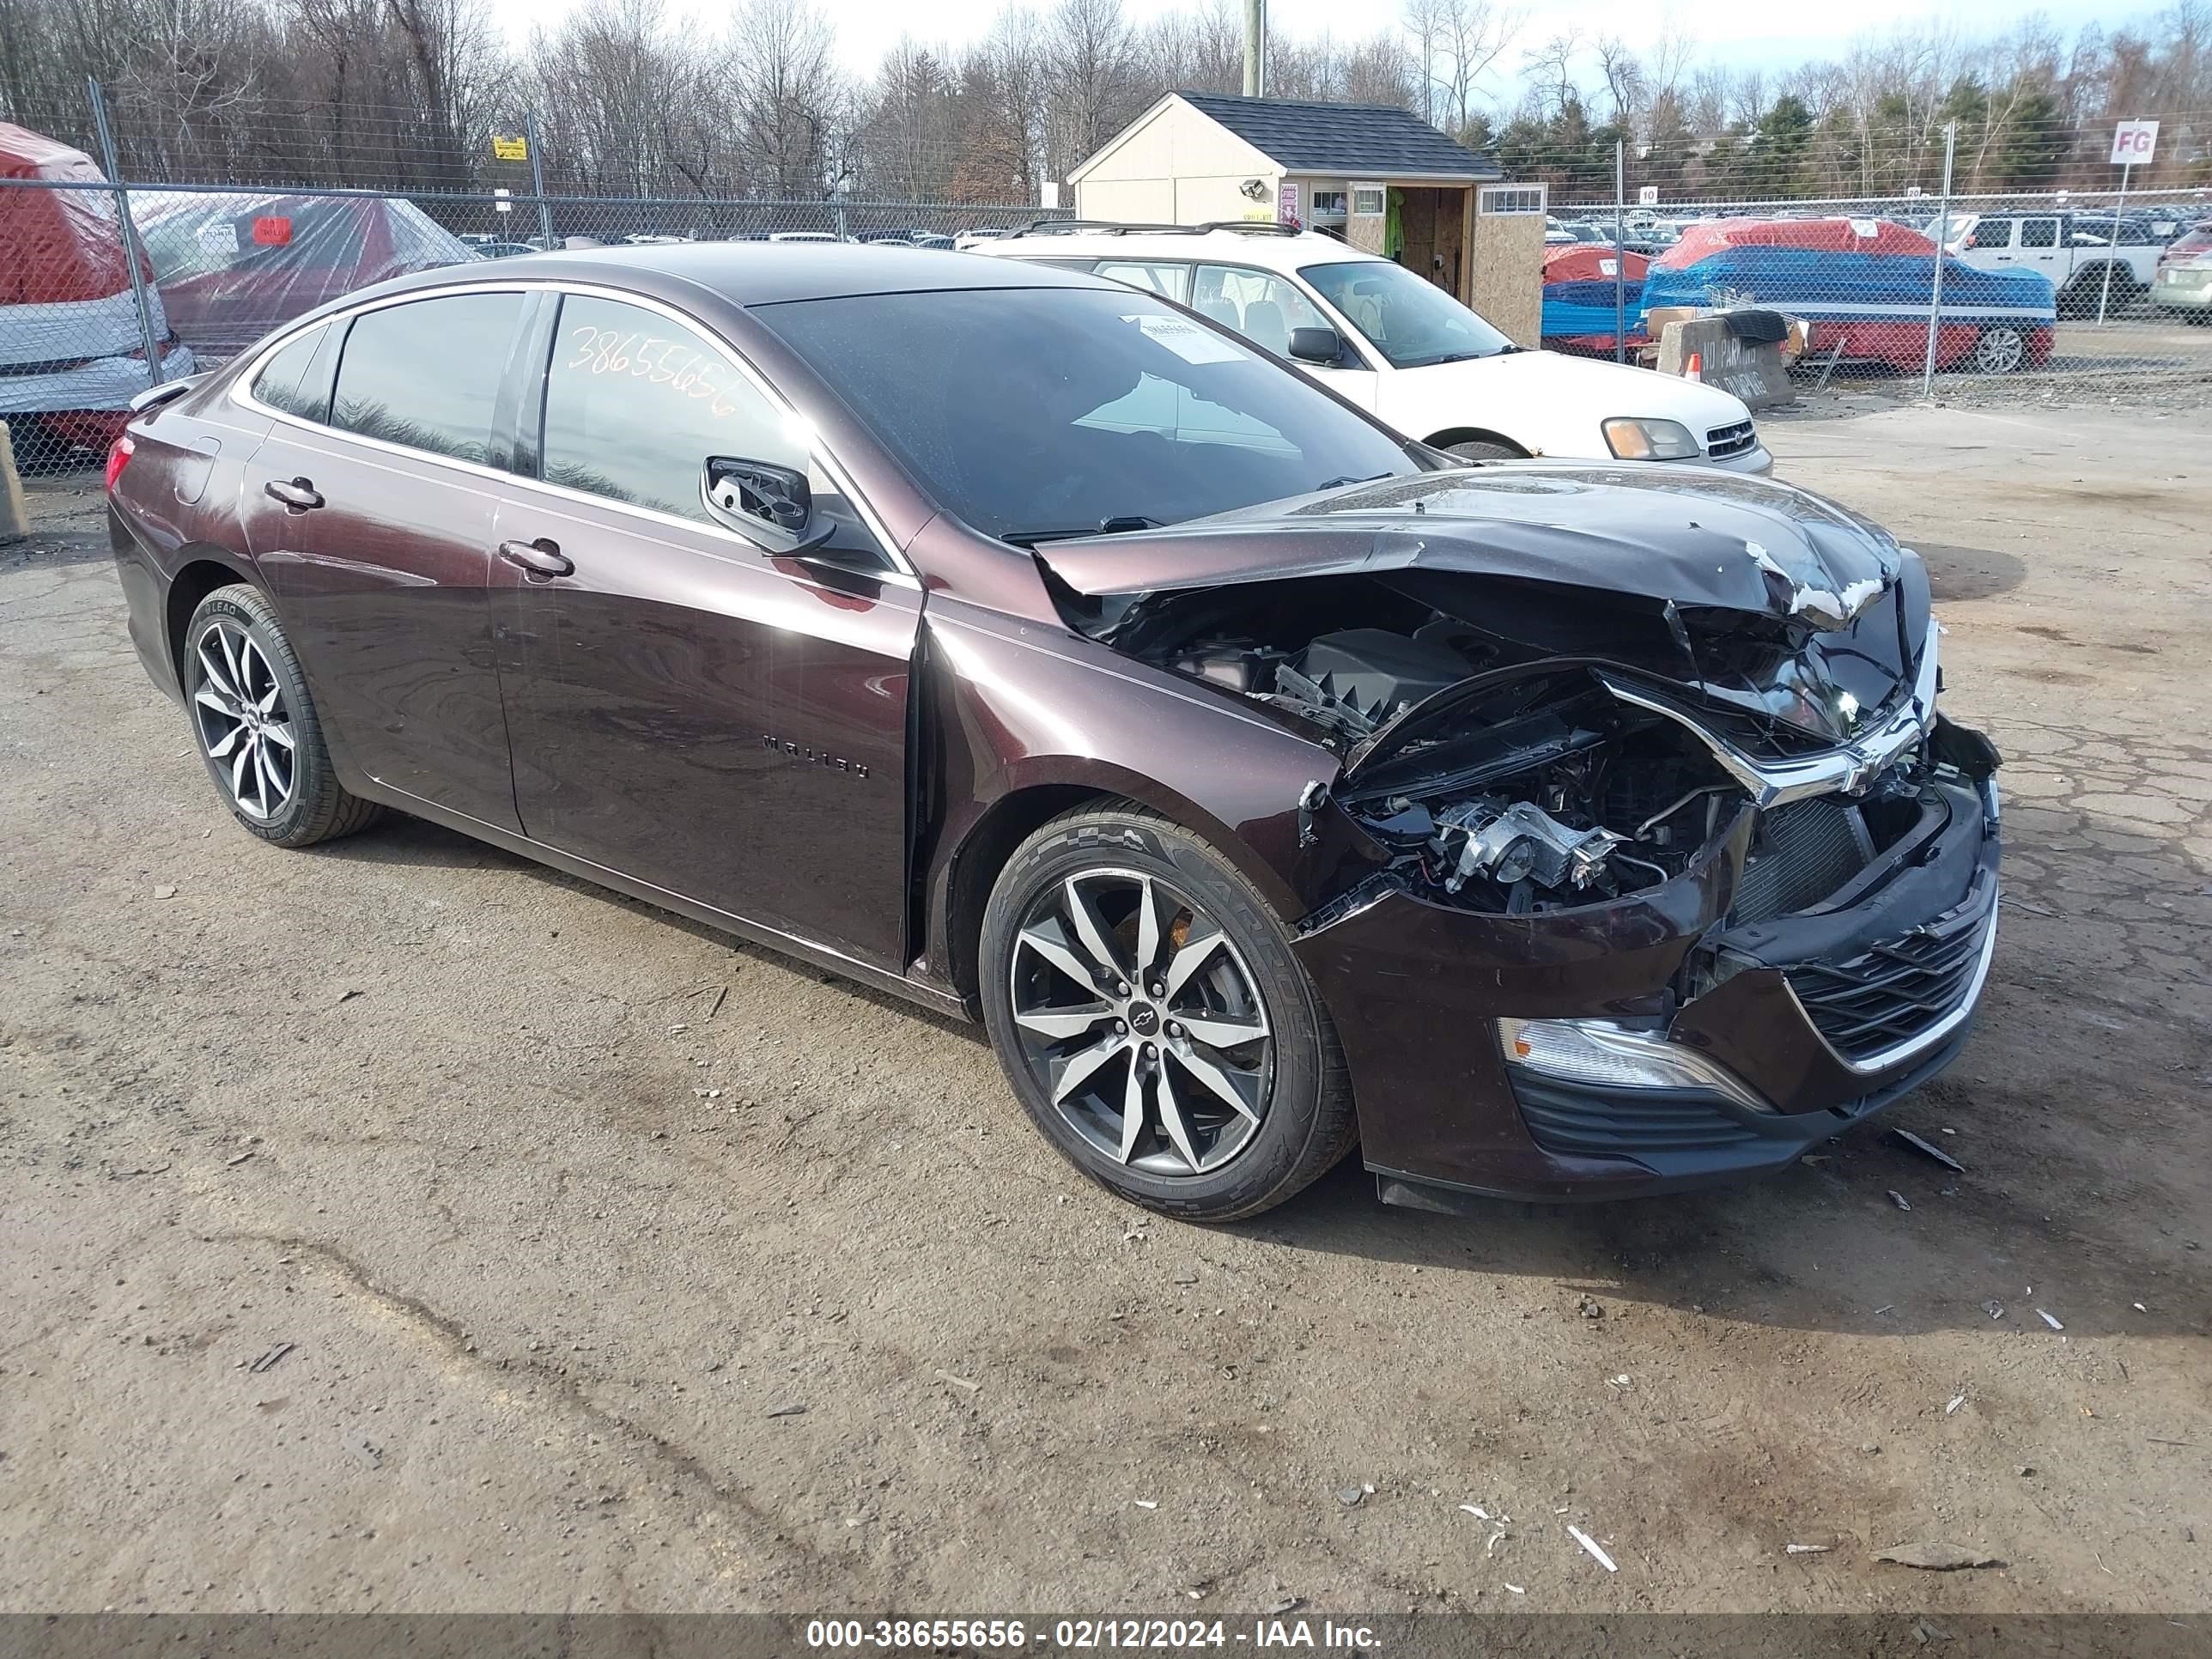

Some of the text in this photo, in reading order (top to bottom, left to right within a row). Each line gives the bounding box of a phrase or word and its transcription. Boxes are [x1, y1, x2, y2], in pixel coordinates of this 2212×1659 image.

[2118, 131, 2151, 153] FG
[1644, 191, 1655, 200] 10
[1703, 337, 1757, 371] NO PARKING
[568, 326, 742, 418] 38655656
[763, 734, 870, 780] MALIBU
